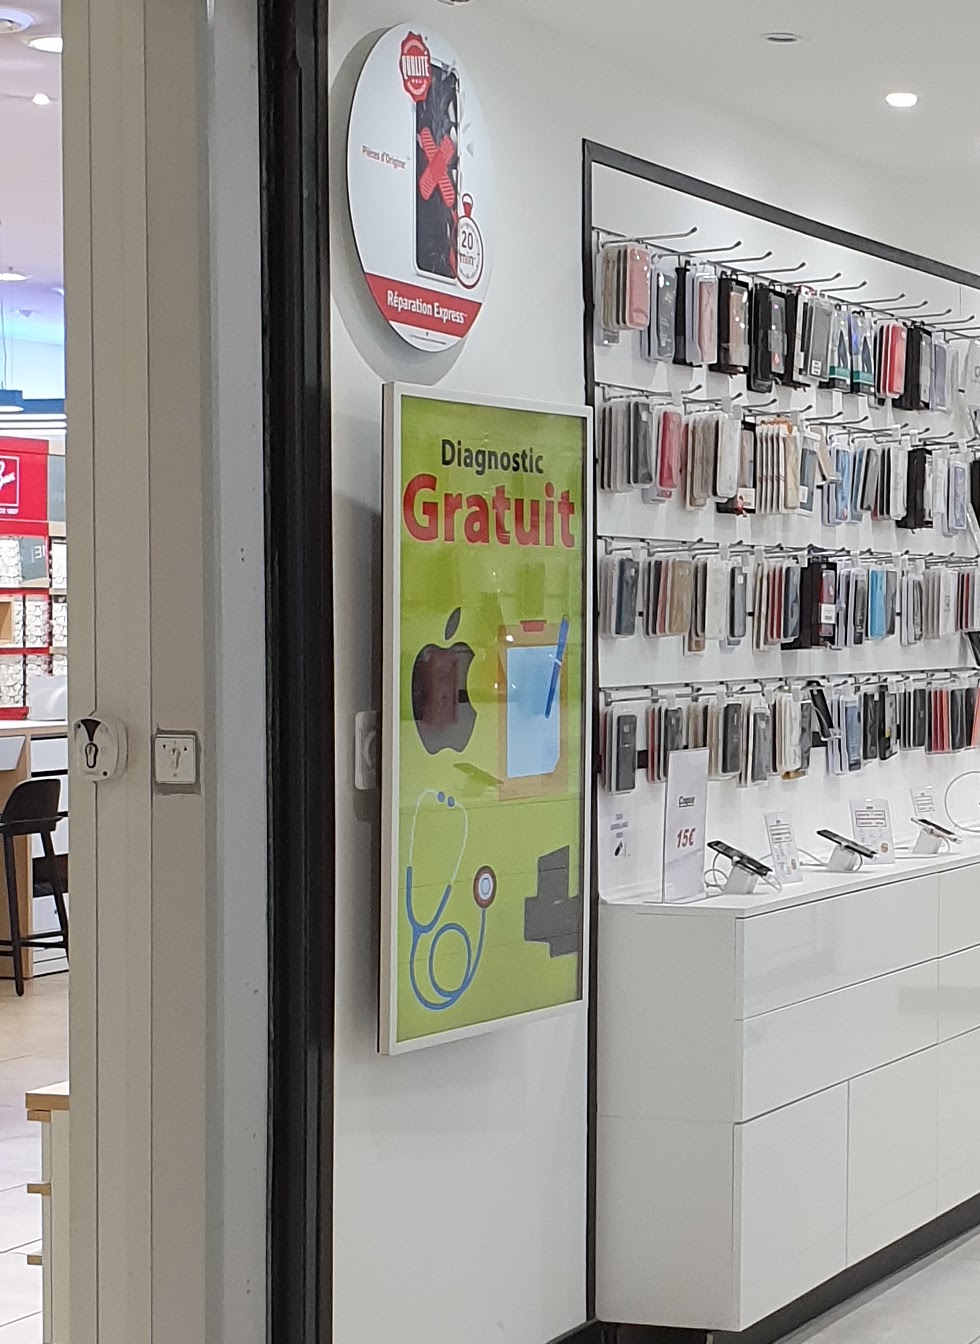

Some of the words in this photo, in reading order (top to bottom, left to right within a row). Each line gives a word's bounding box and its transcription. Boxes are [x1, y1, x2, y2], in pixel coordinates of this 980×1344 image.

[461, 230, 474, 250] 20
[387, 290, 433, 316] Réparation
[434, 302, 465, 324] Express
[441, 439, 545, 476] Diagnostic
[402, 472, 576, 549] Gratuit
[676, 827, 696, 849] 15€
